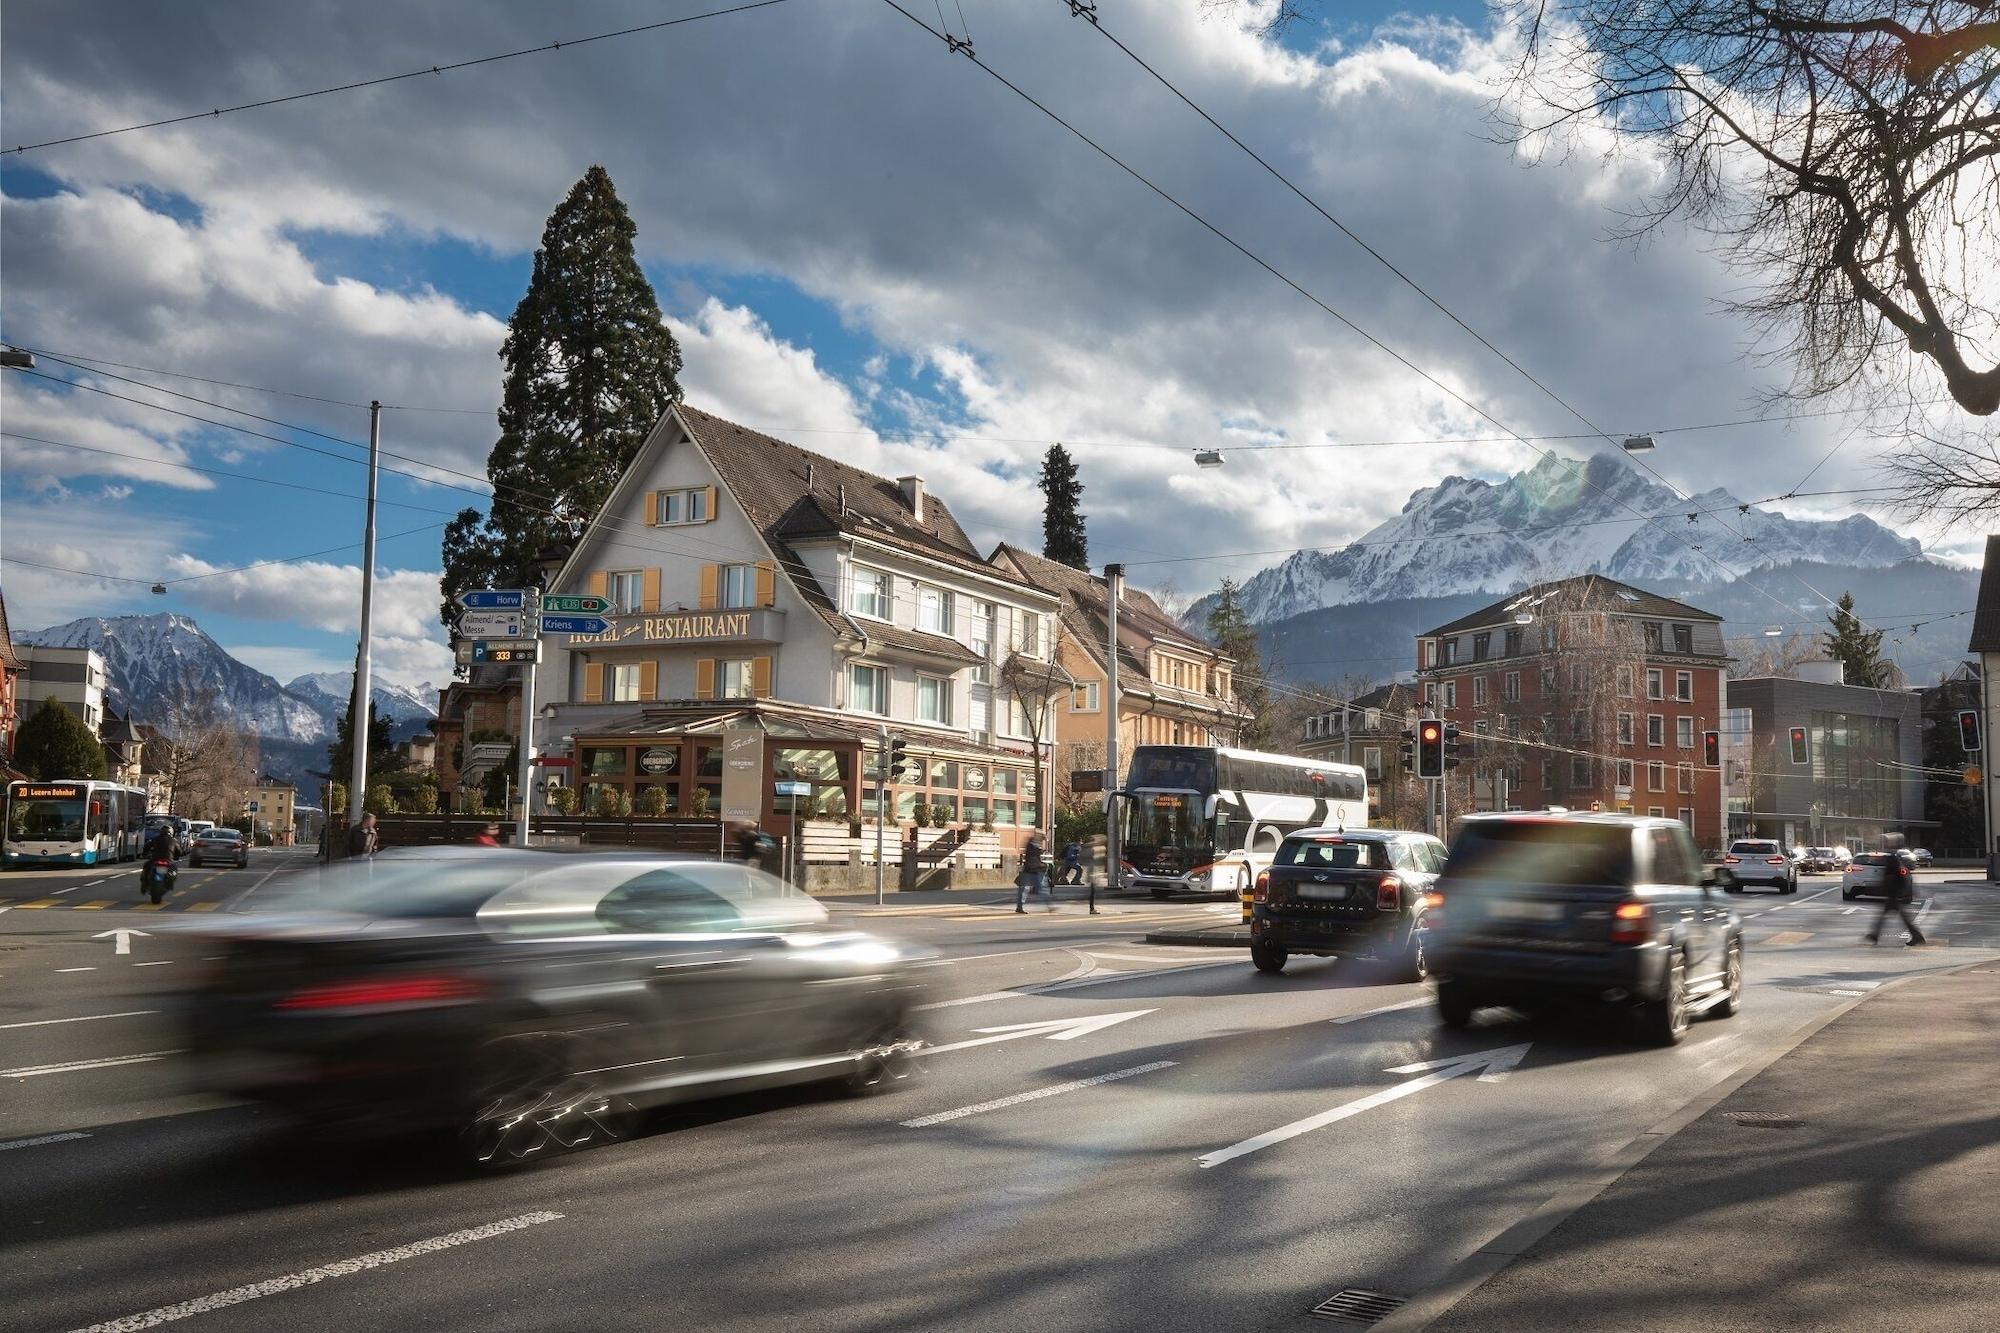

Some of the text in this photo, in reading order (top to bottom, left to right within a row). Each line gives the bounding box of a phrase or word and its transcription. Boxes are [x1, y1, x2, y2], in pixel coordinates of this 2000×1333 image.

[497, 596, 518, 604] Horw
[465, 616, 493, 624] Allmend/
[545, 620, 572, 629] Kriens
[465, 626, 485, 634] Messe
[644, 614, 750, 640] RESTAURANT
[475, 648, 483, 657] P
[496, 651, 510, 660] 333
[19, 788, 76, 797] 20 Luzern Bahnhof
